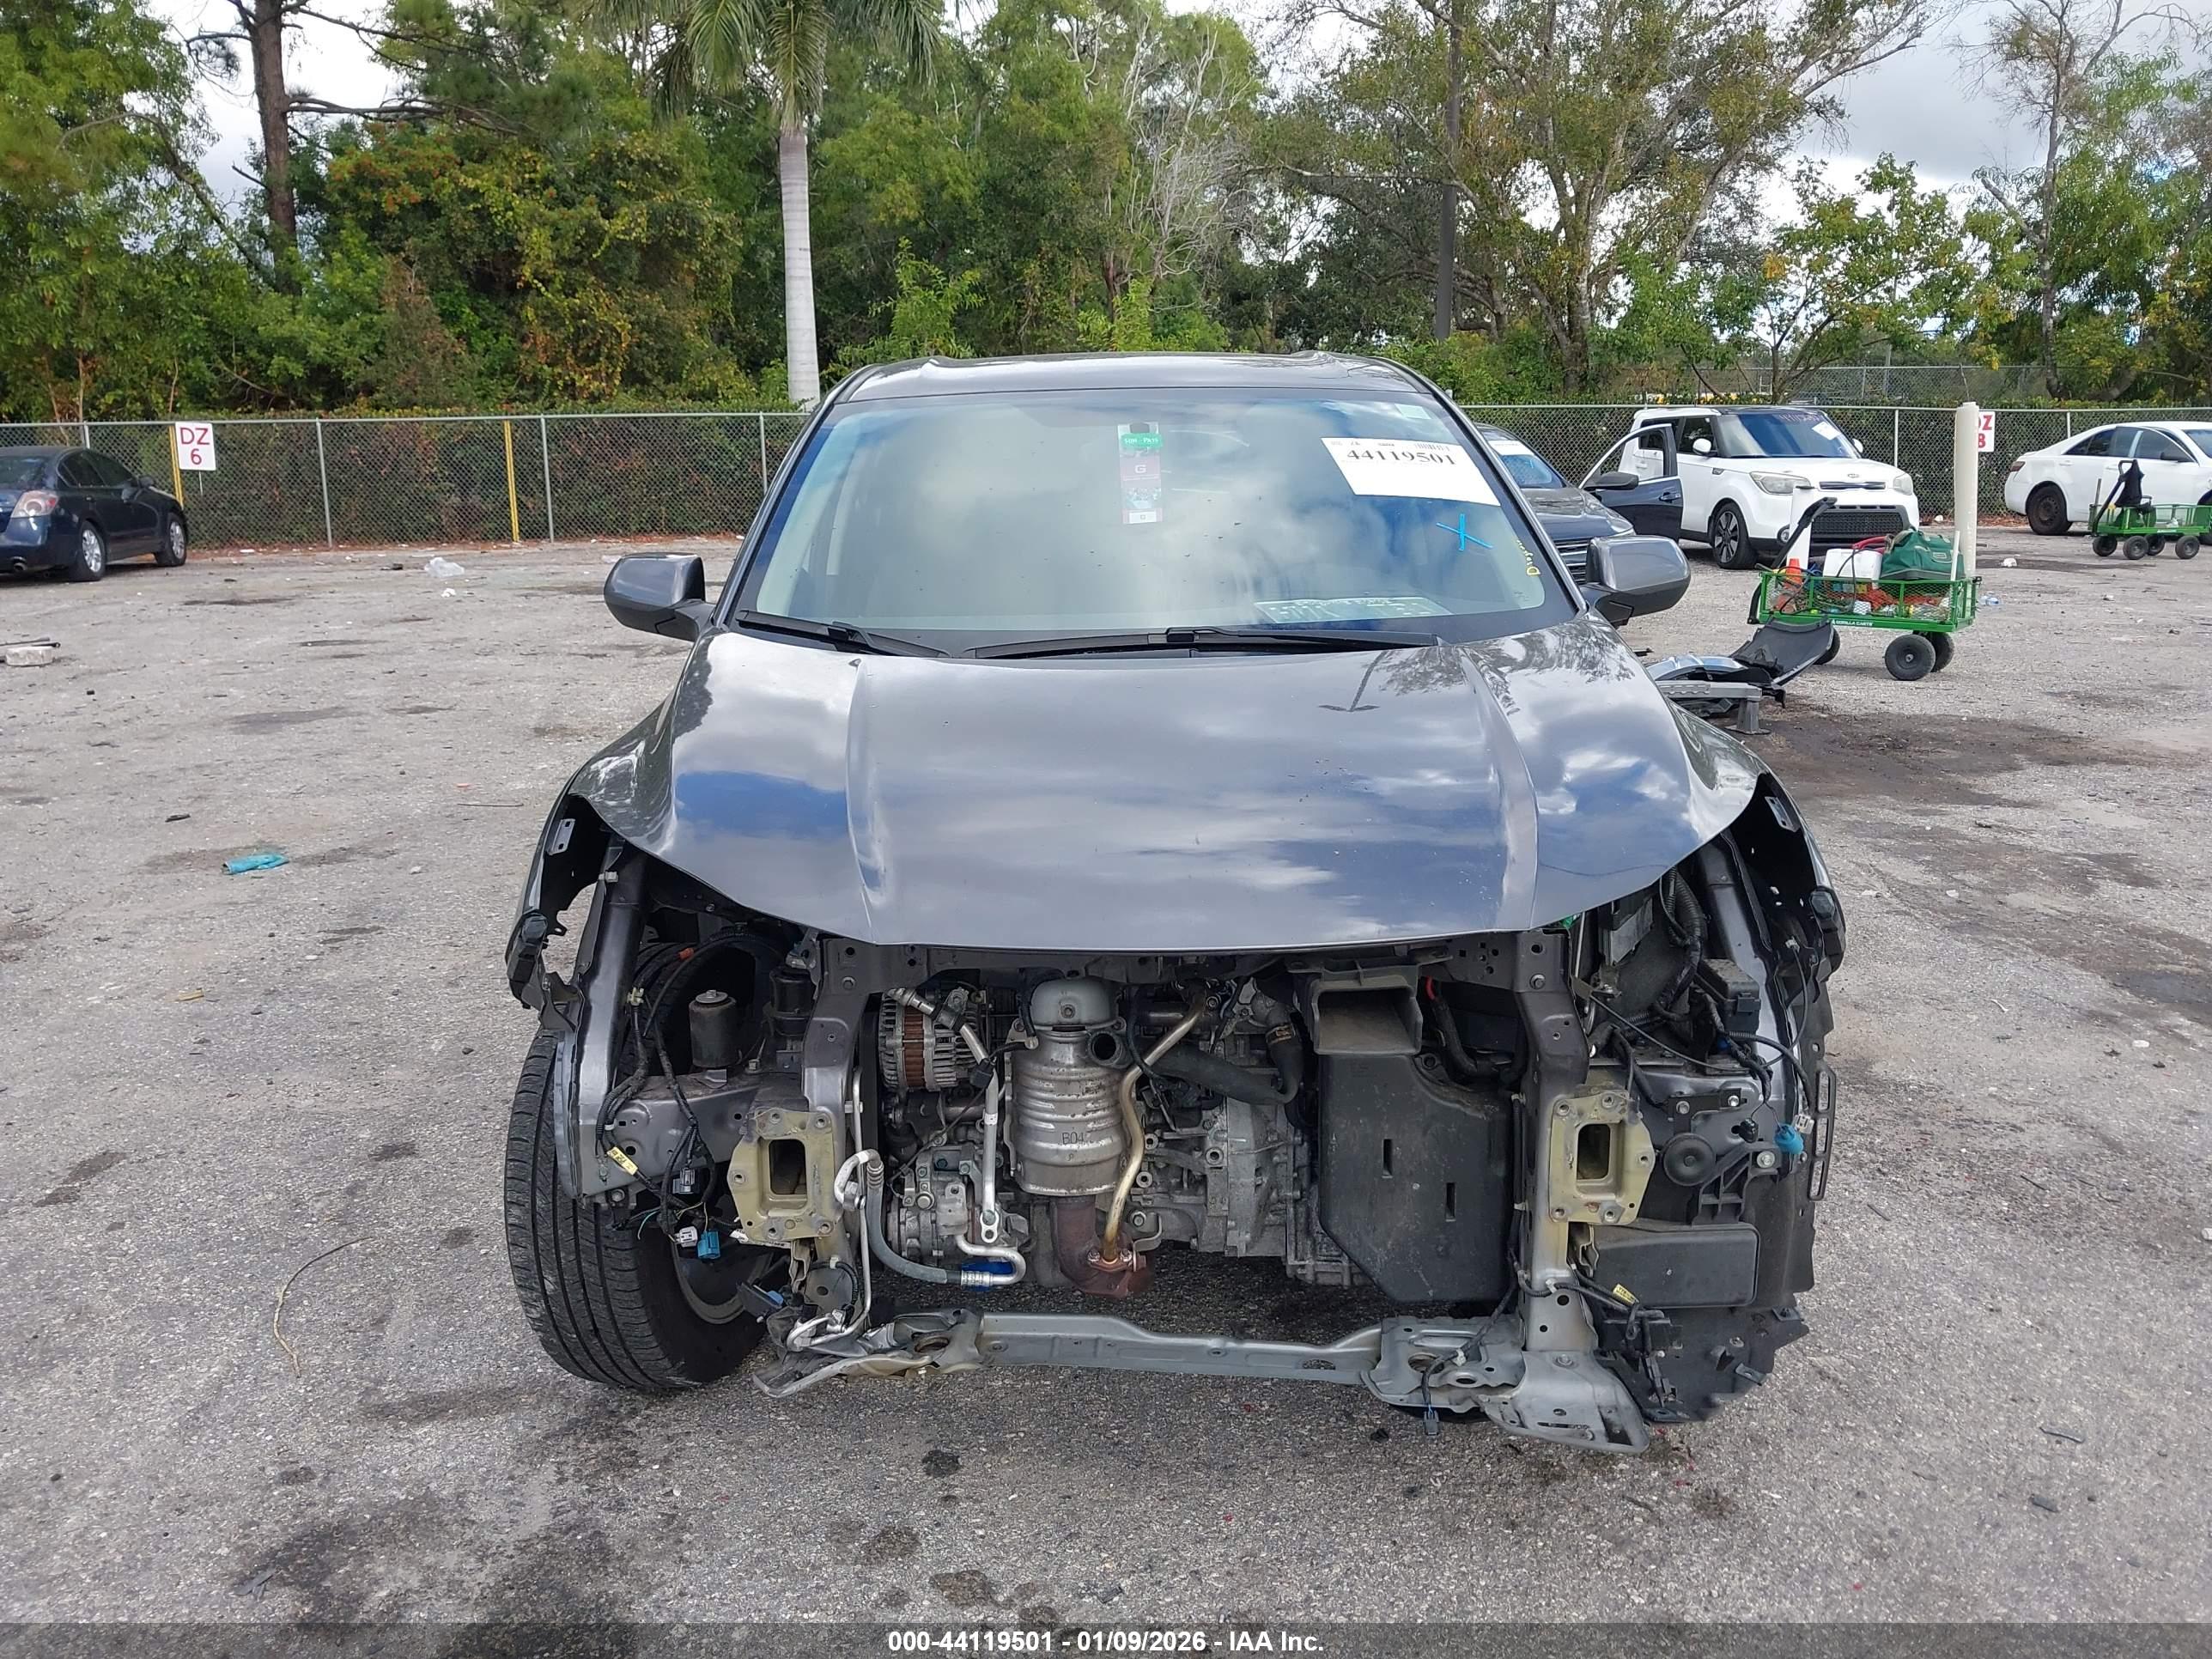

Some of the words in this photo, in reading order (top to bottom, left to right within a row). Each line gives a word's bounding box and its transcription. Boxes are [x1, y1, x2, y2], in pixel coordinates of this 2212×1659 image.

[179, 427, 210, 446] DZ
[191, 447, 203, 465] 6
[1346, 449, 1457, 465] 44119501
